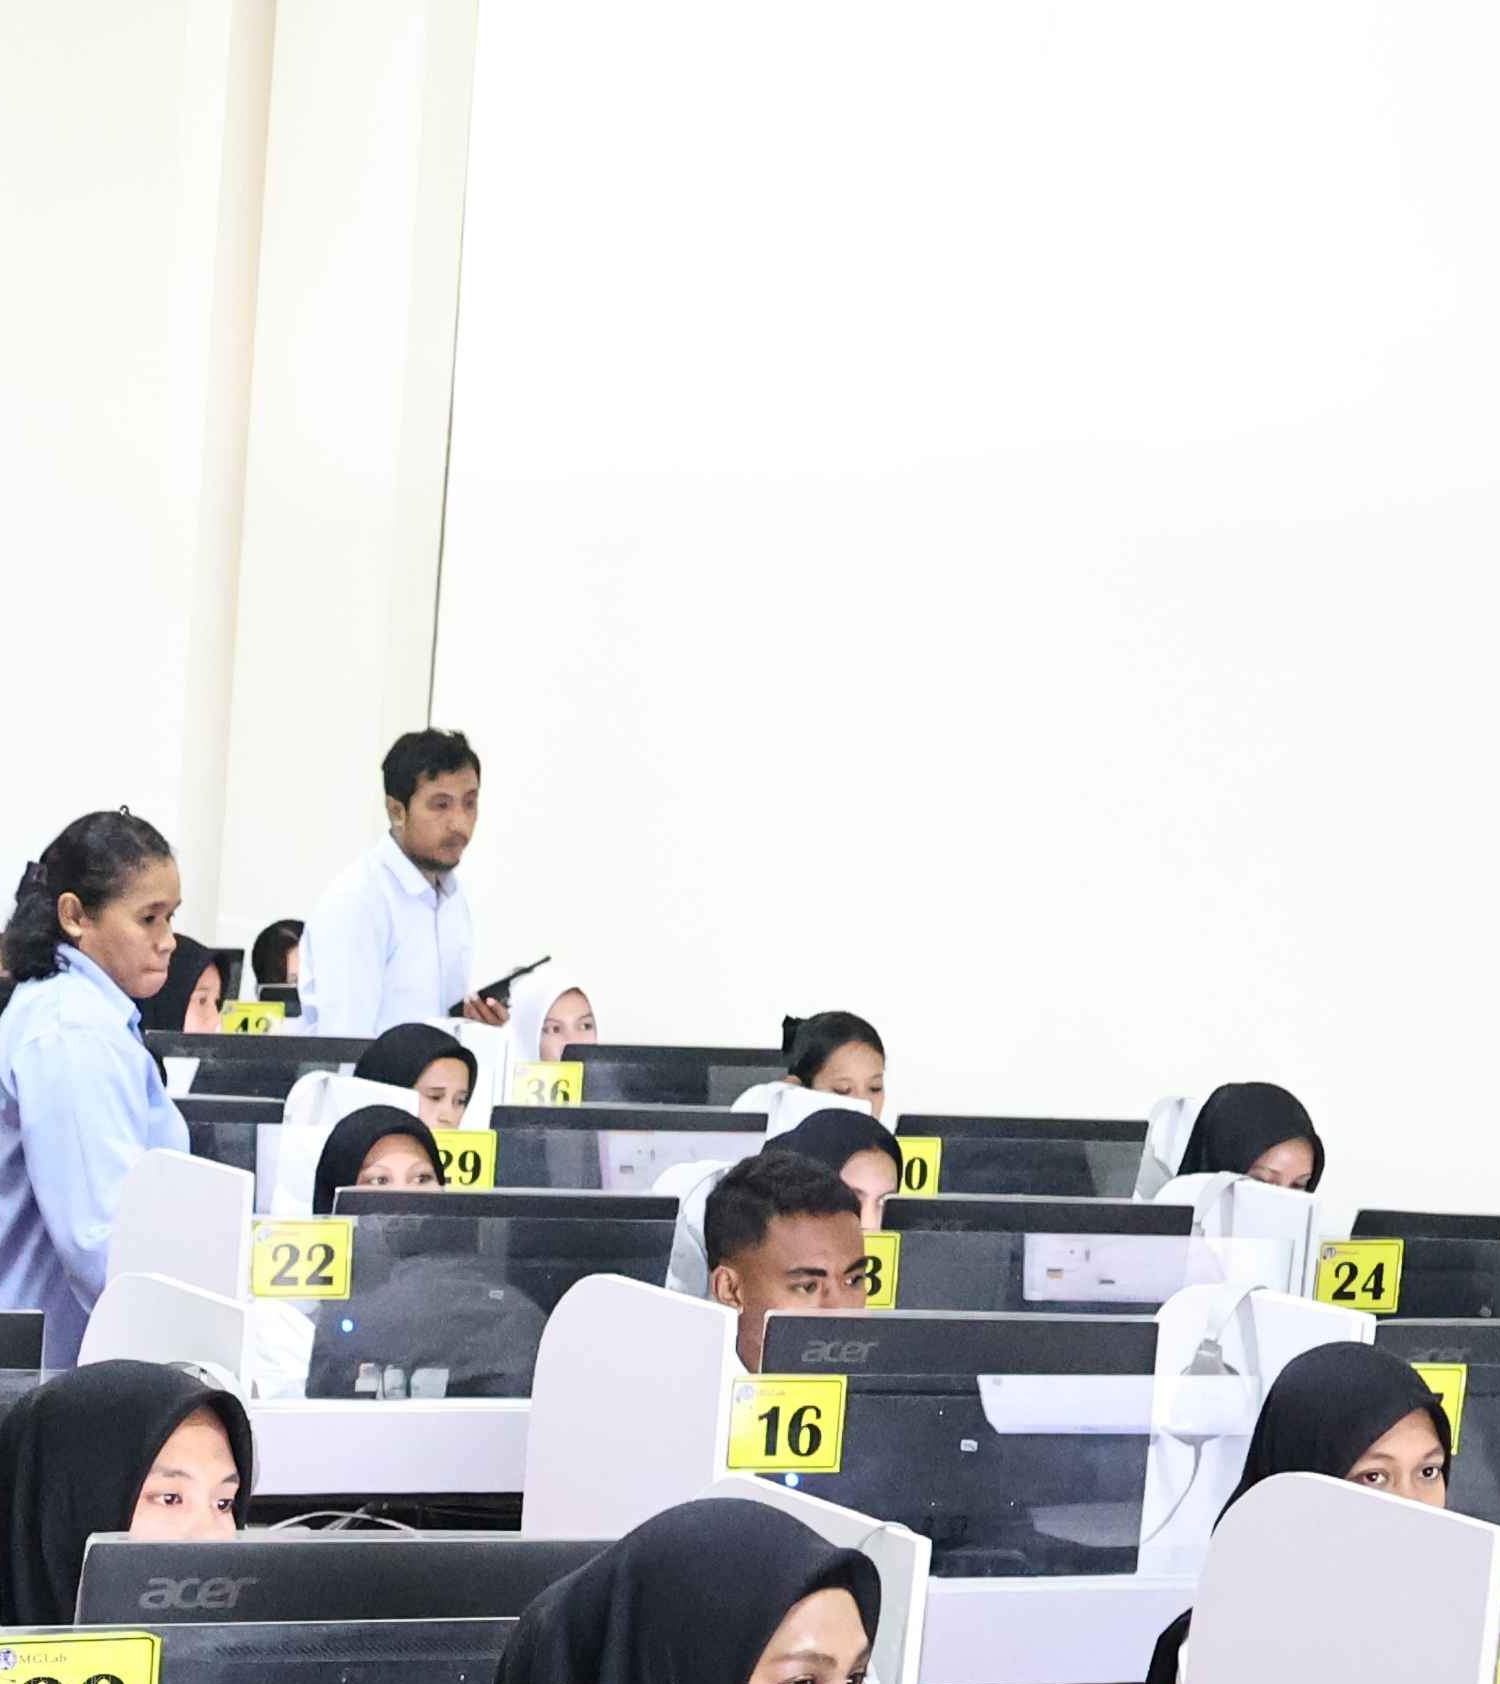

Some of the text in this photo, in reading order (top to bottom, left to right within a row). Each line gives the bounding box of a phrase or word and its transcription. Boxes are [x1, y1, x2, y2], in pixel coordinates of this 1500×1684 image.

[527, 1078, 571, 1105] 36
[438, 1149, 482, 1187] 29
[269, 1242, 336, 1287] 22
[1331, 1261, 1386, 1301] 24
[800, 1339, 879, 1363] acer
[757, 1404, 823, 1457] 16
[138, 1576, 261, 1610] acer
[17, 1652, 68, 1665] MGLab
